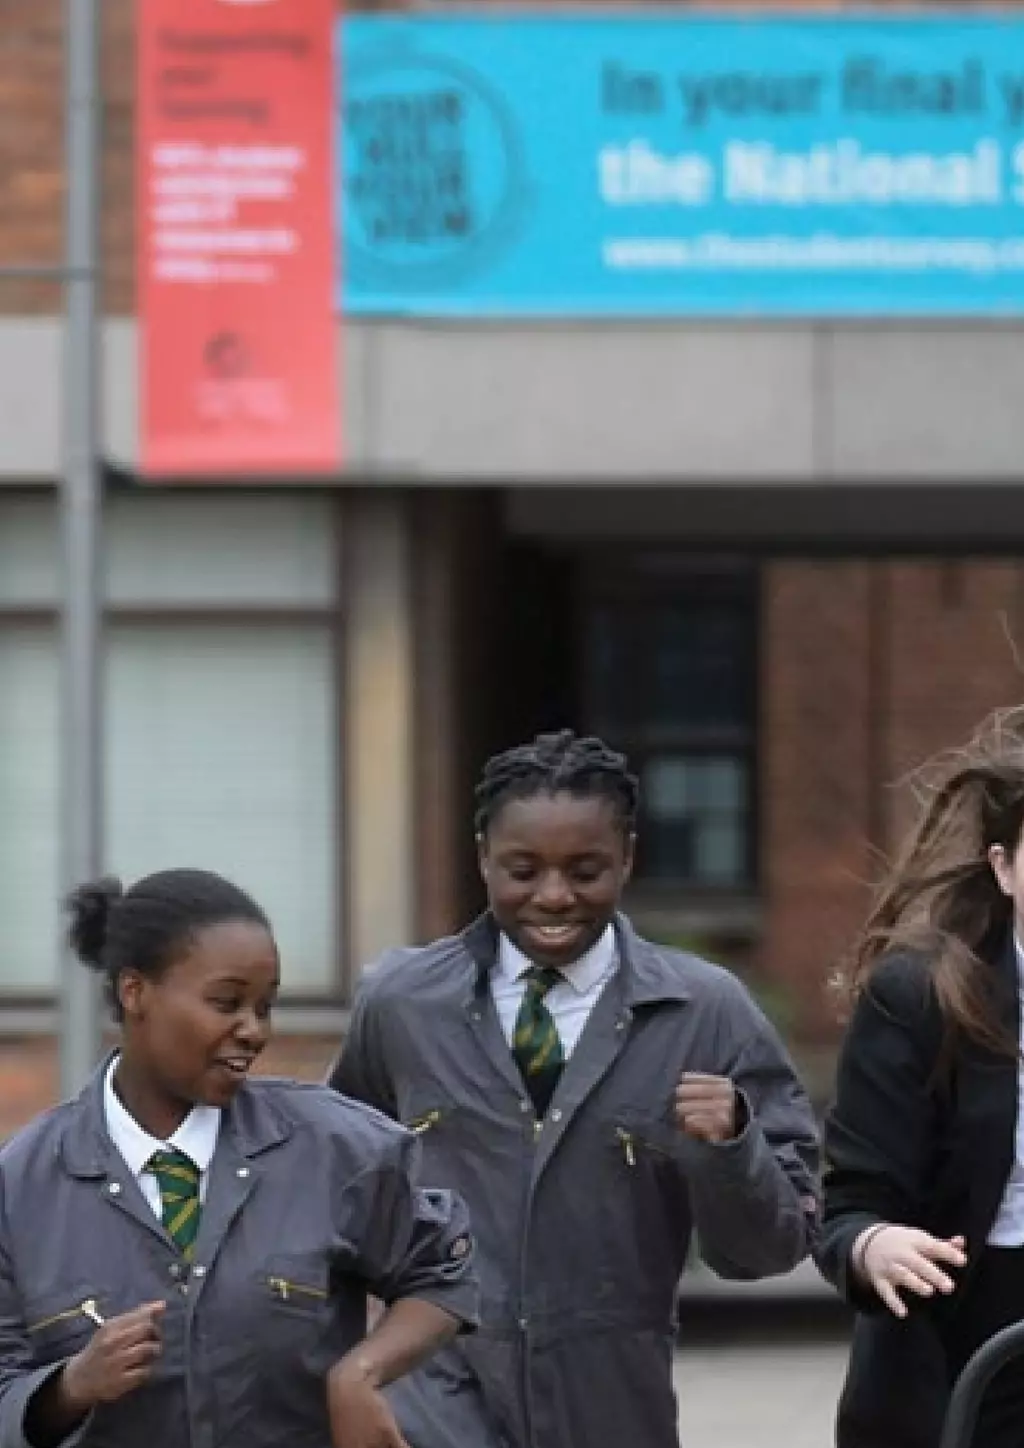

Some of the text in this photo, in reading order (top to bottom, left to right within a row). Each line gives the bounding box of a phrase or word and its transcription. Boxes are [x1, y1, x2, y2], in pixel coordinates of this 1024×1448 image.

[601, 60, 664, 114] In
[679, 71, 820, 128] your
[838, 56, 988, 114] final
[600, 138, 713, 206] the
[723, 138, 1003, 207] National
